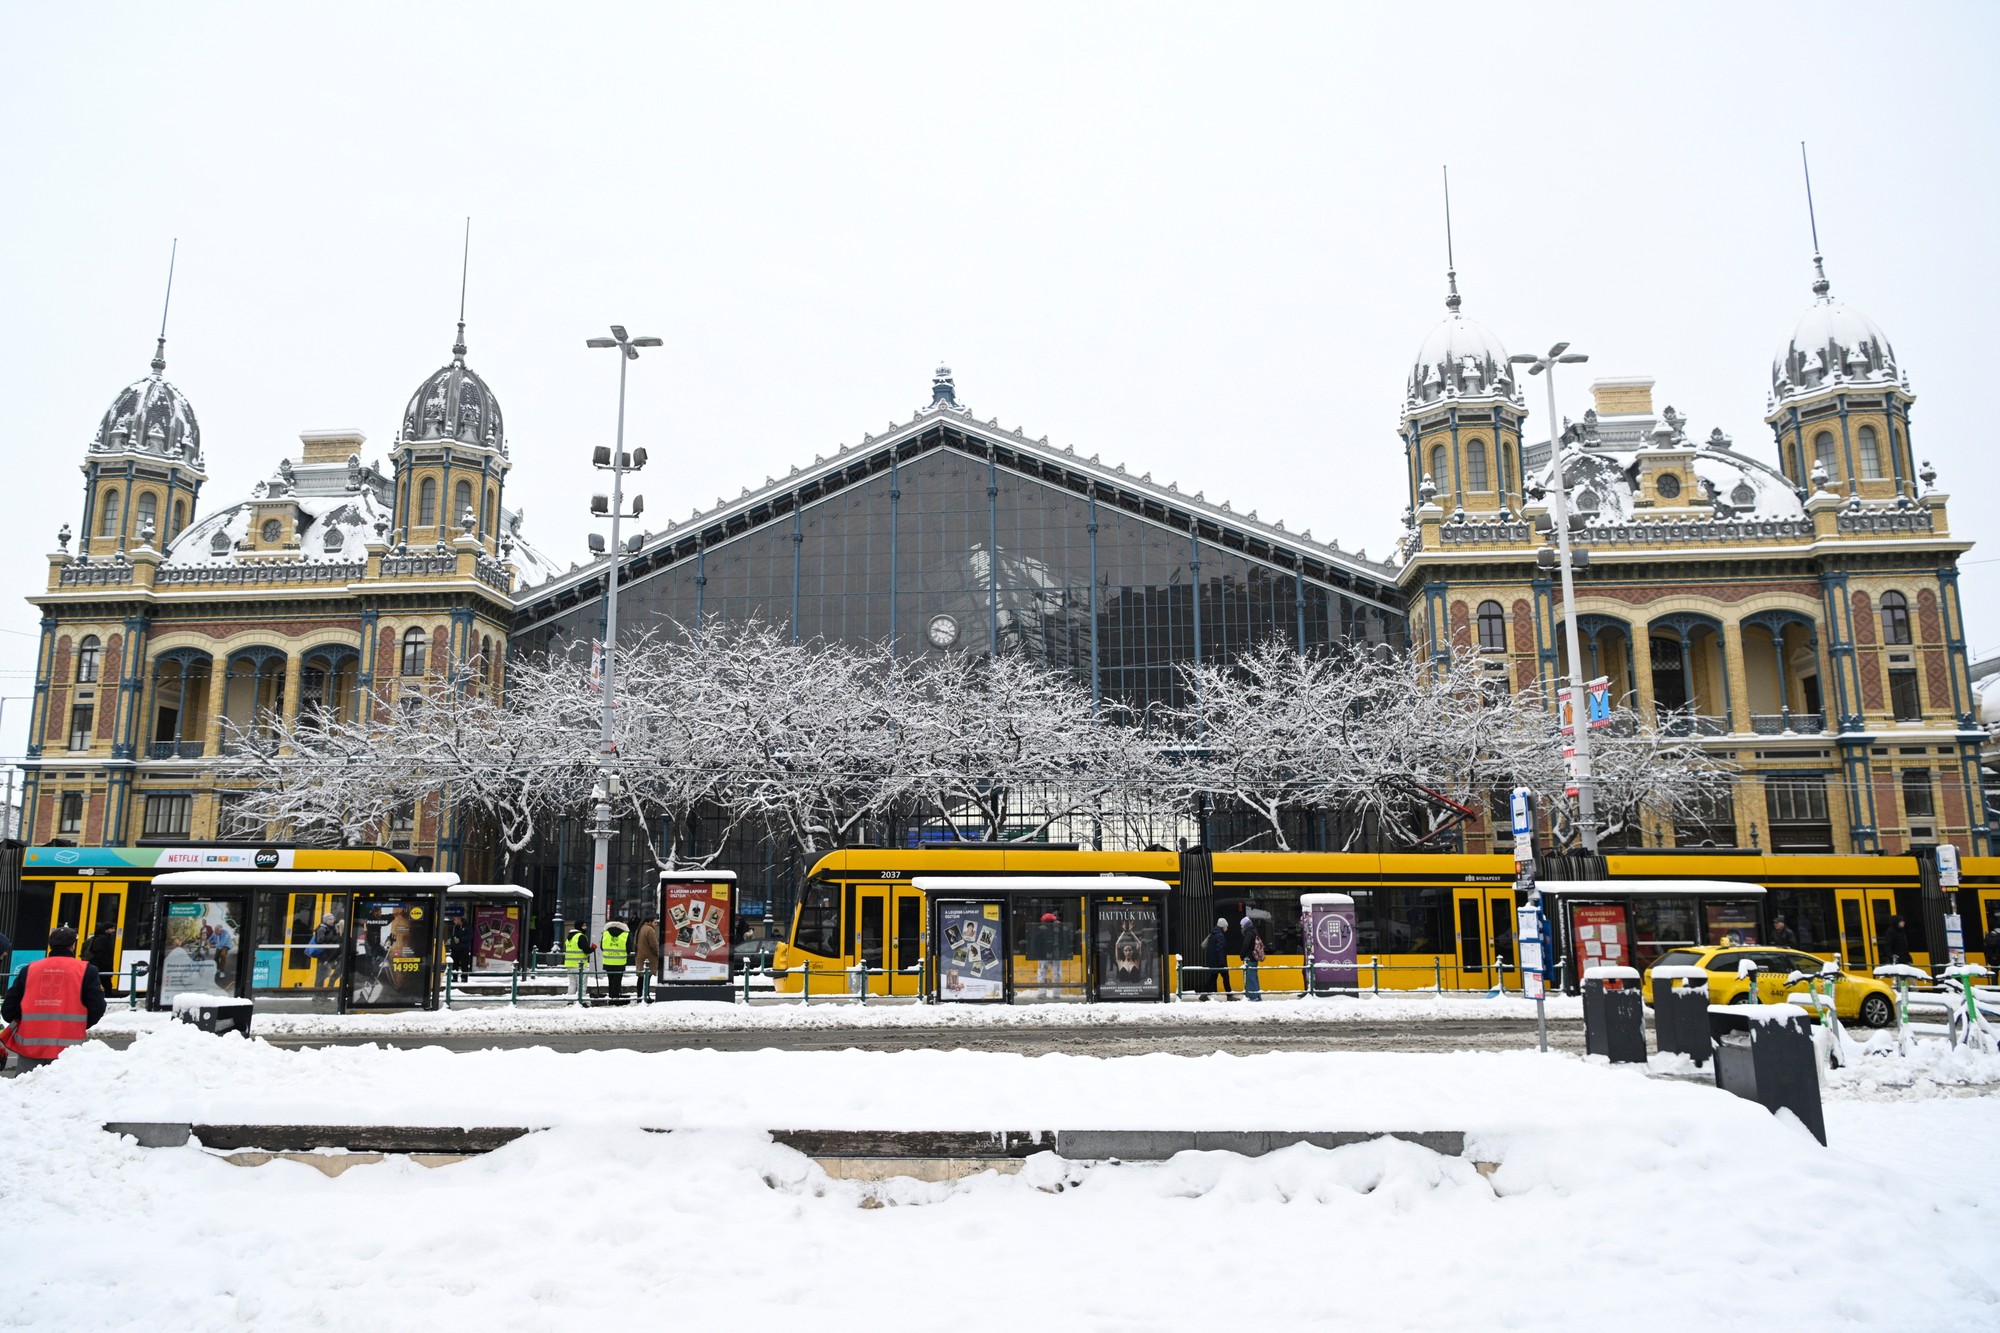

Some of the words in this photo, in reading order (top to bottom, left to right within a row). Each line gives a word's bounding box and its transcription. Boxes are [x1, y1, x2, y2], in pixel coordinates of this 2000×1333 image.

[168, 854, 199, 863] NETFLIX
[256, 854, 277, 862] one
[881, 871, 901, 879] 2037
[1098, 908, 1135, 921] HATTYÚK
[1136, 911, 1156, 921] TAVA
[393, 963, 402, 971] 14
